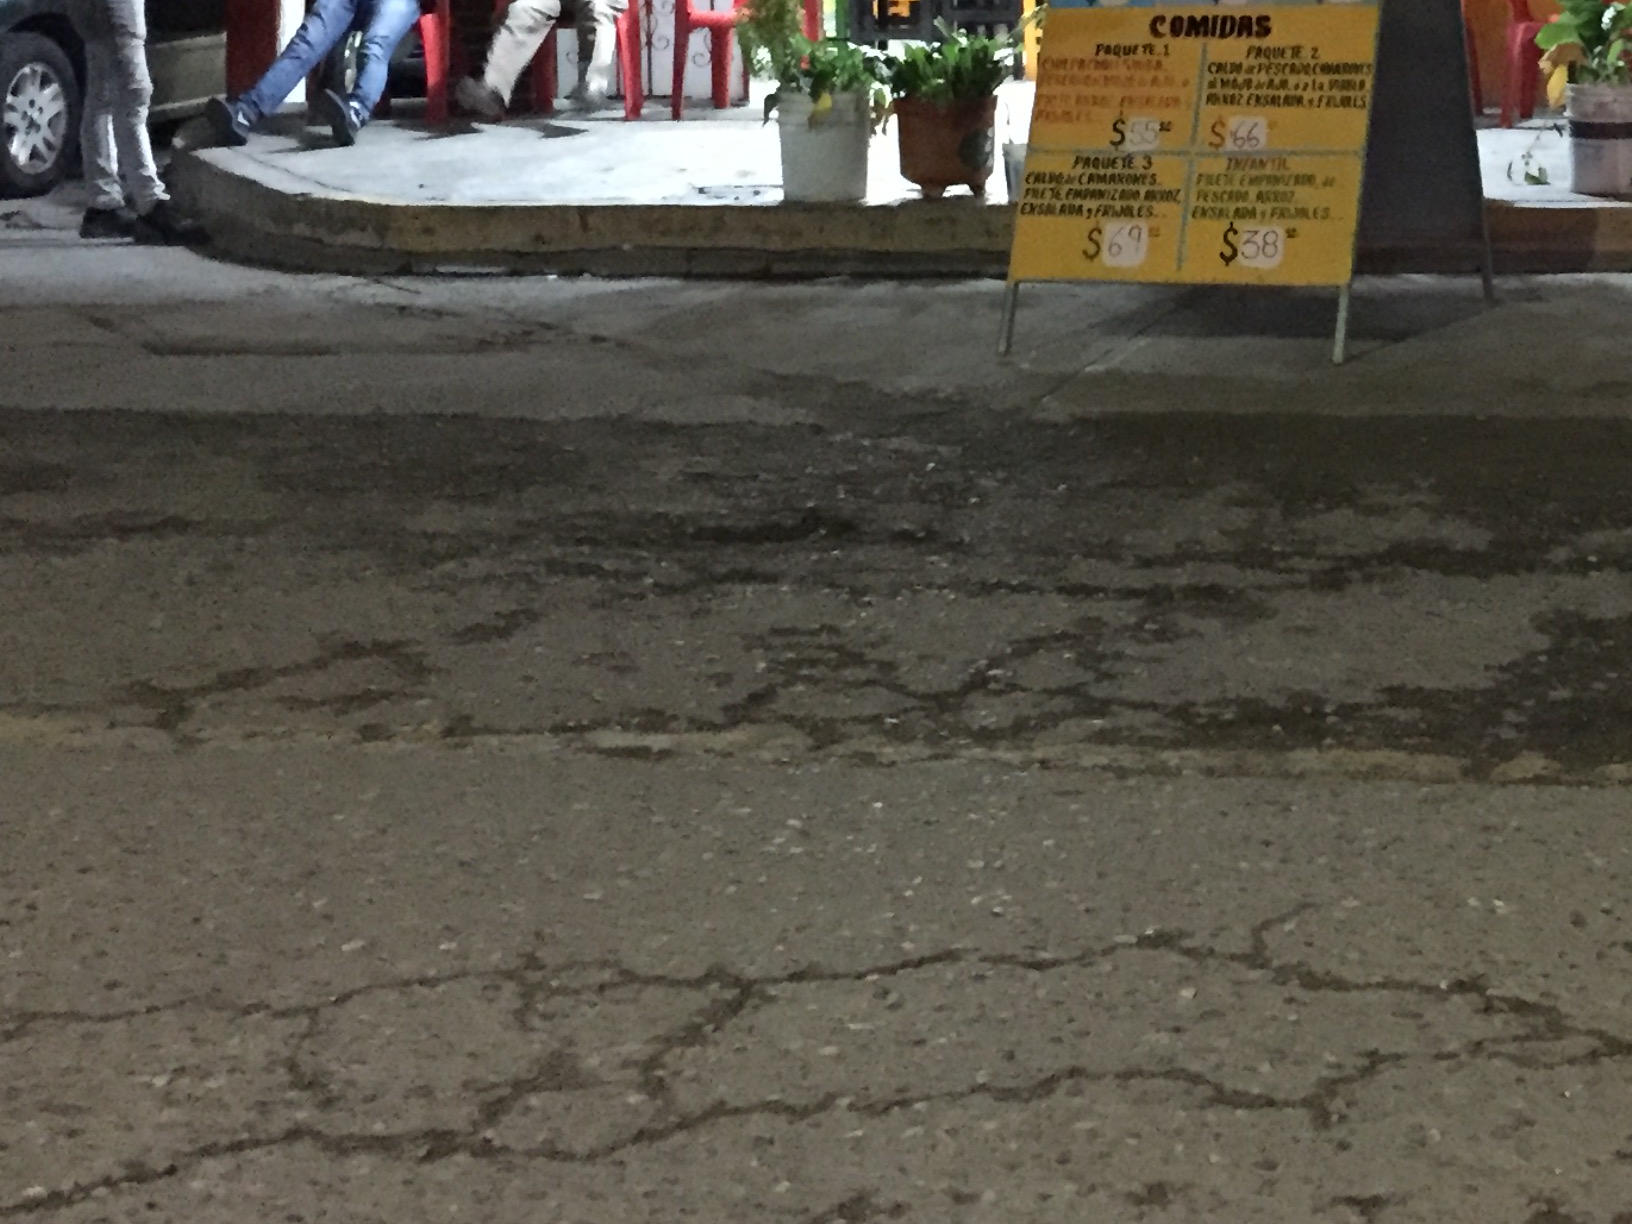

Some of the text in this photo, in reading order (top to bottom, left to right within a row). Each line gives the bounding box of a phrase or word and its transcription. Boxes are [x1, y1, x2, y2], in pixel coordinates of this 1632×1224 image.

[1149, 14, 1273, 39] COMIDAS
[1311, 47, 1320, 60] 2
[1208, 114, 1261, 150] $66
[1142, 156, 1153, 170] 3
[1082, 222, 1143, 261] $69
[1219, 221, 1279, 266] $38
